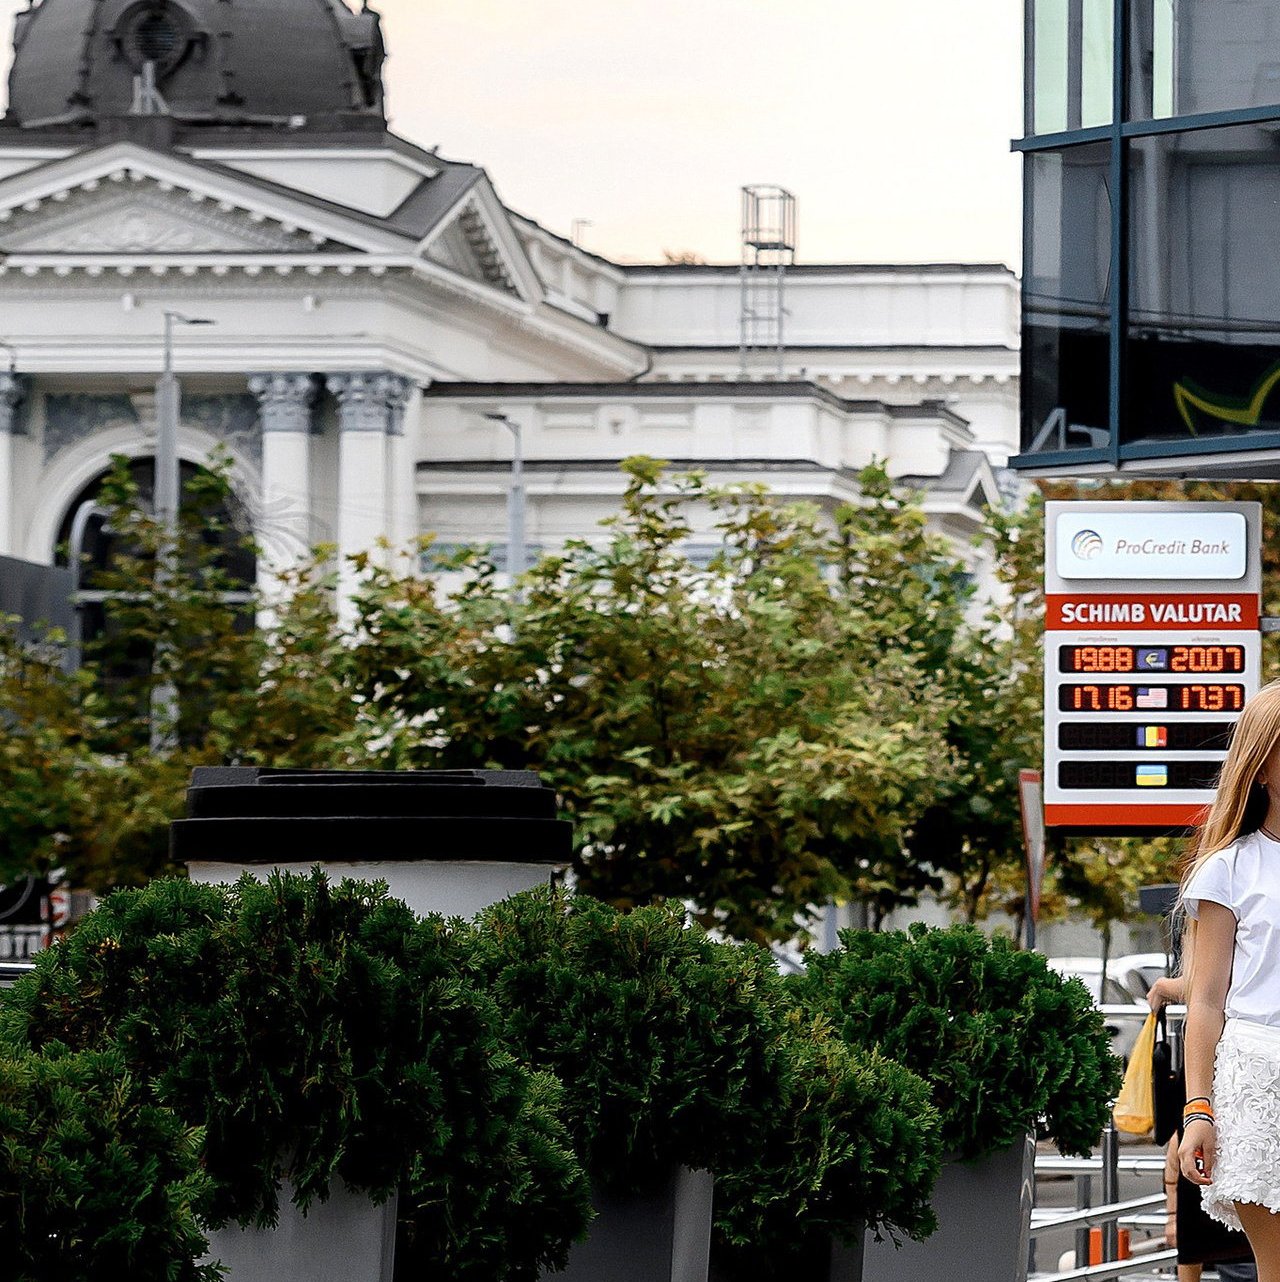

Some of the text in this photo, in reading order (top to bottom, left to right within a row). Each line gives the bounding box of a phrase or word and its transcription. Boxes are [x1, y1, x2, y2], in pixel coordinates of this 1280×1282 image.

[1115, 539, 1229, 555] ProCredit Bank
[1061, 603, 1242, 623] SCHIMB VALUTAR
